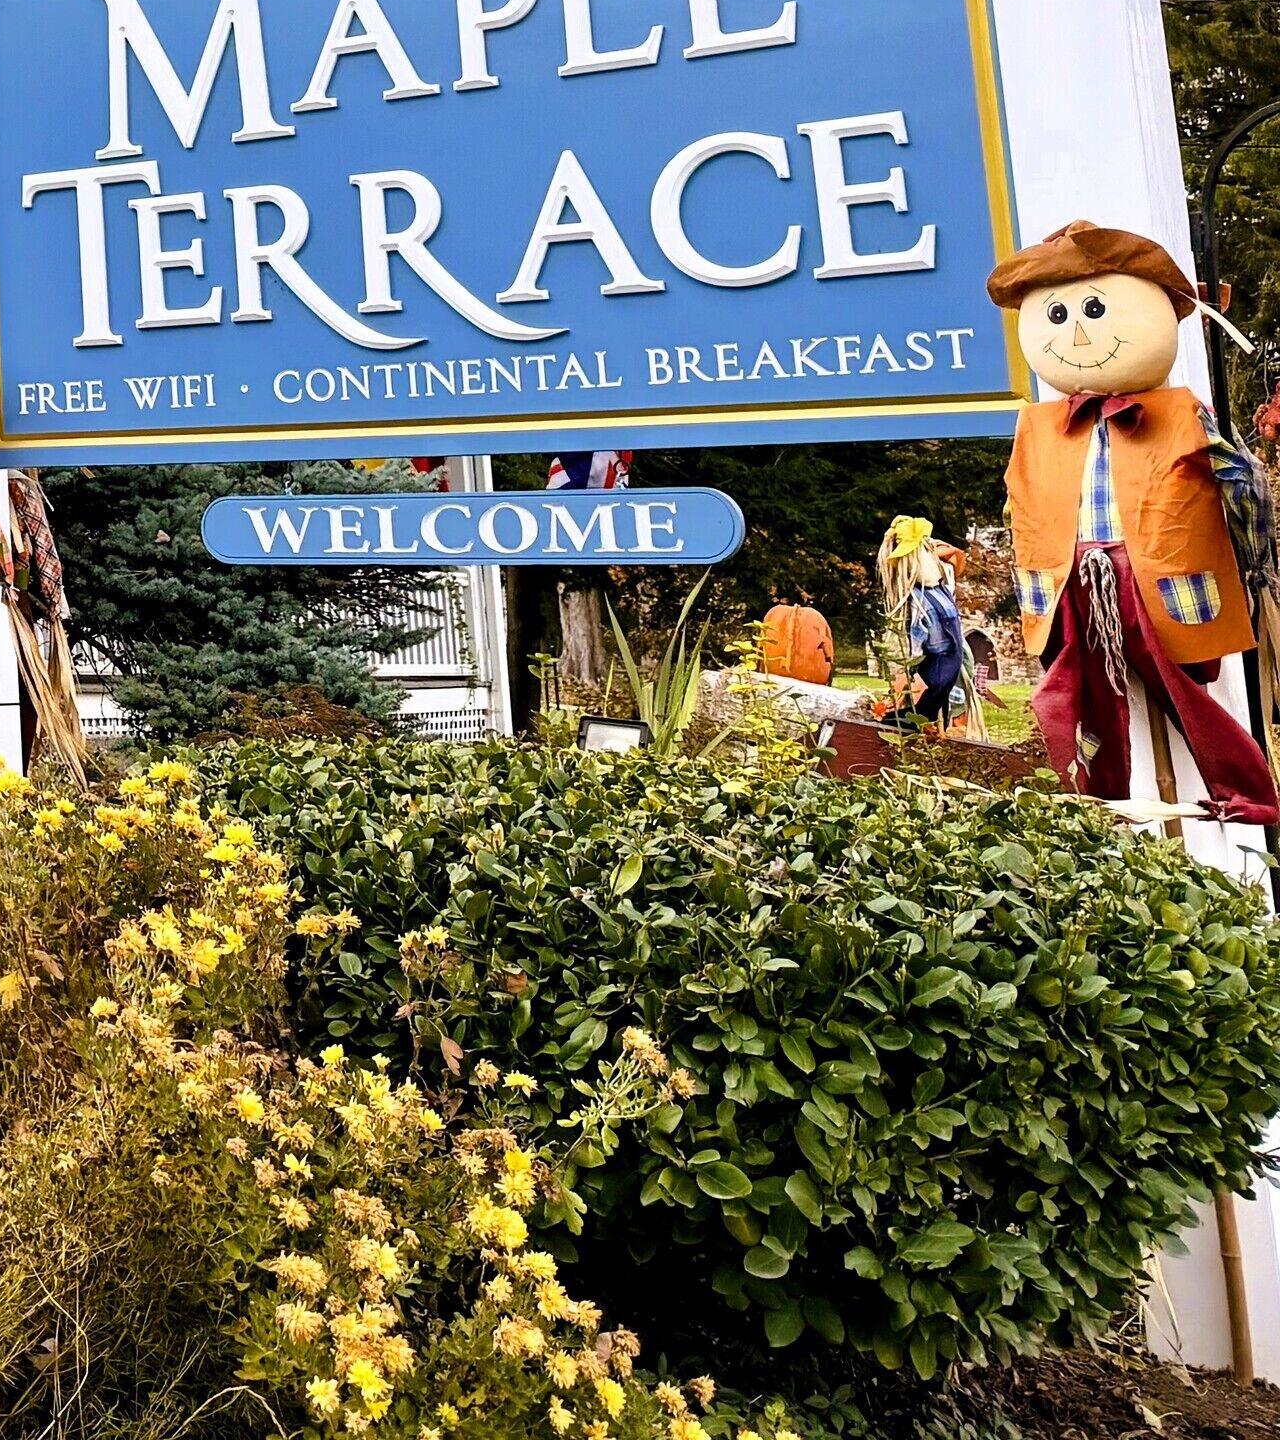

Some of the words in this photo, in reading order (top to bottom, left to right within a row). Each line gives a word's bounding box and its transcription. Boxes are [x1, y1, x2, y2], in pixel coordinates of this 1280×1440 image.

[20, 110, 937, 351] TERRACE
[18, 380, 107, 415] FREE
[123, 373, 217, 411] WIFI
[273, 352, 623, 404] CONTINENTAL
[645, 327, 975, 385] BREAKFAST
[241, 501, 685, 555] WELCOME
